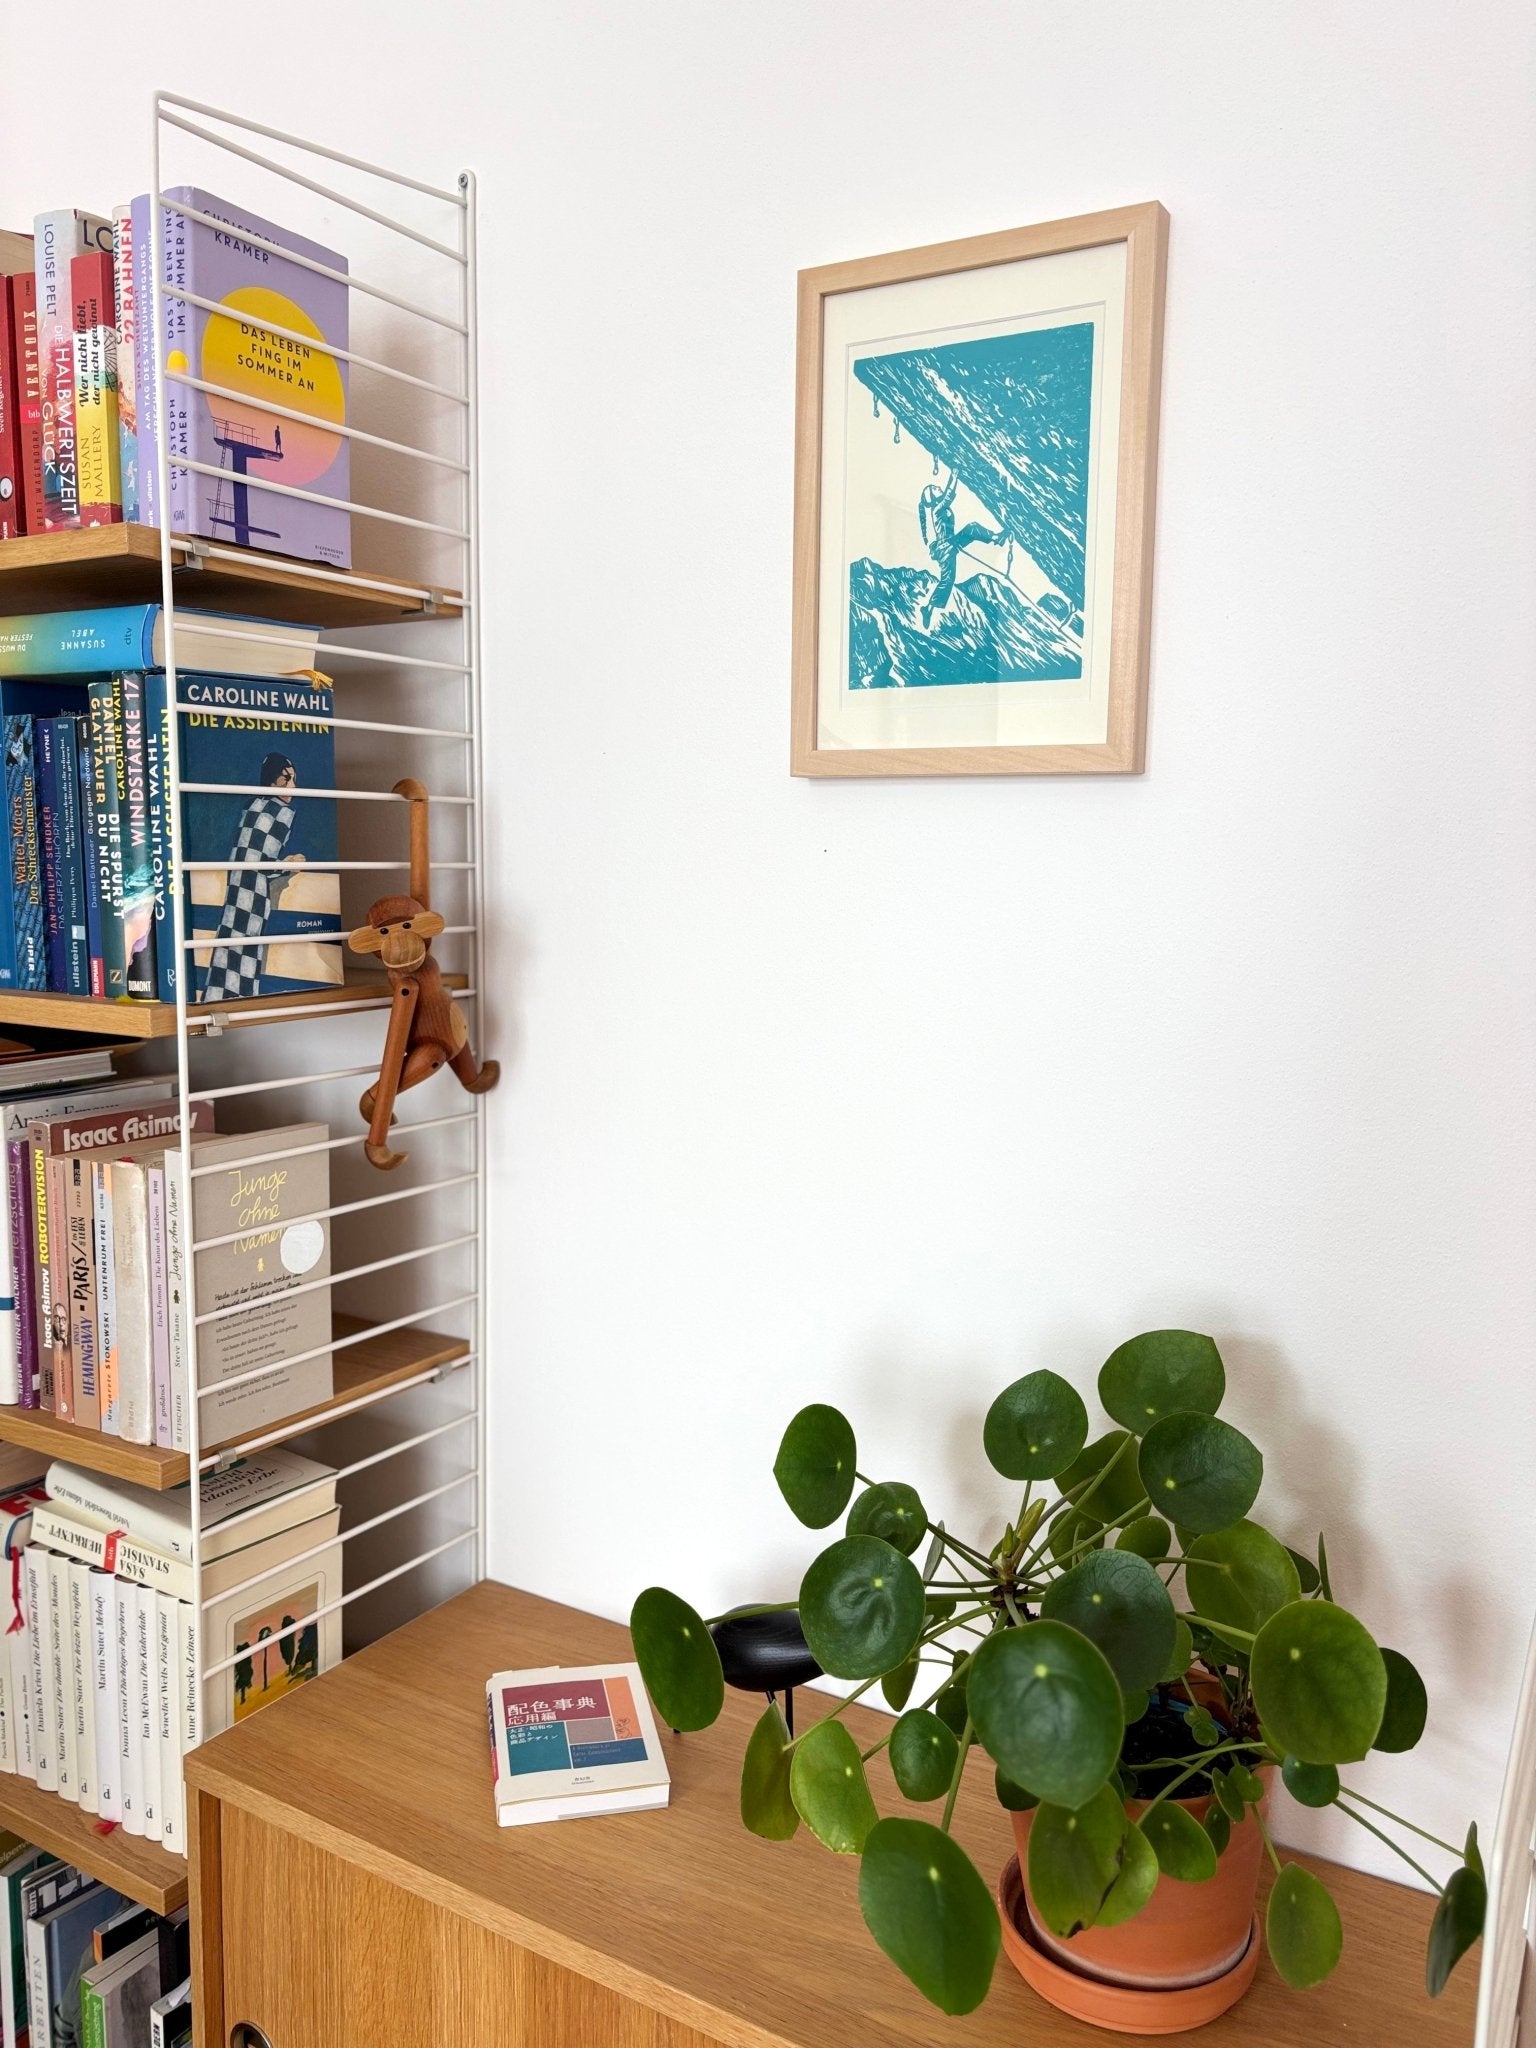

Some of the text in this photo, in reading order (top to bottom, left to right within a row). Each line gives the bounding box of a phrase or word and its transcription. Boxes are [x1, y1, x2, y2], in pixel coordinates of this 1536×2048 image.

[214, 231, 270, 265] KRAMER
[44, 224, 57, 316] LOUISE PELT
[166, 251, 174, 301] LBEN
[114, 267, 123, 345] CAROLINE
[141, 243, 149, 354] WELTUNTERGANGS
[166, 309, 174, 340] DAS
[177, 315, 186, 334] IM
[241, 323, 311, 359] DAS LEBEN
[23, 310, 39, 397] VENTOUX
[90, 298, 101, 406] der nicht gewinnt
[142, 358, 150, 381] DES
[251, 343, 302, 372] FING IM
[77, 338, 89, 408] Wer nicht
[237, 354, 315, 392] SOMMER AN
[54, 325, 77, 515] DIE HALBWERTSZEIT
[144, 412, 151, 430] AM
[42, 401, 56, 475] GLÜCK
[178, 411, 188, 476] KAMER
[32, 430, 43, 494] WAGENDORP
[80, 426, 104, 498] SUSAN MALLERY
[10, 633, 34, 642] FESTER
[60, 639, 106, 651] SUSANNE
[71, 628, 96, 638] ABEL
[123, 627, 132, 646] dtv
[187, 684, 330, 711] CAROLINE WAHL
[103, 697, 116, 765] DANIEL
[112, 678, 126, 801] CAROLINE WAHL
[189, 712, 330, 734] DIE ASSISTENTIN
[82, 747, 91, 789] Nordwind
[91, 698, 106, 804] GLATTAUER
[123, 678, 147, 847] WINDSTÄRKE 17
[85, 790, 93, 818] gegen
[12, 796, 28, 885] Walter Moers
[22, 775, 40, 905] Der Schrecksenmeister
[86, 819, 94, 835] Gut
[147, 733, 166, 921] CAROLINE WAHL
[42, 806, 58, 935] JAN-PHILIPP SENDKER
[97, 813, 111, 902] DU NICHT
[108, 813, 125, 920] DIE SPURST
[296, 919, 323, 928] ROMAN
[26, 937, 36, 972] PIPER
[70, 941, 81, 988] ullstein
[92, 960, 100, 994] GOLDMANN
[128, 980, 152, 993] DUMONT
[63, 1125, 119, 1152] Isaac
[122, 1111, 198, 1143] Asimov
[228, 1169, 288, 1207] Junge
[34, 1149, 50, 1265] ROBOTERVISION
[71, 1216, 79, 1233] FEST
[238, 1196, 281, 1227] ohne
[77, 1217, 86, 1240] LEBEN
[40, 1267, 52, 1315] Asimov
[99, 1219, 111, 1370] STOKOWSKI UNTENRUM FREI
[43, 1317, 53, 1349] Isaac
[173, 1313, 181, 1342] Tasane
[73, 1316, 95, 1397] ERNEST HEMINGWAY
[247, 1468, 278, 1485] Erbe
[49, 1524, 103, 1555] HERKUNFT
[28, 1568, 39, 1610] Ernstfall
[51, 1574, 59, 1609] Mondes
[31, 1625, 40, 1649] Liebe
[52, 1612, 60, 1628] des
[118, 1601, 128, 1647] Begehren
[32, 1649, 41, 1667] Die
[53, 1629, 61, 1653] Seite
[94, 1595, 107, 1691] Martin Suter Melody
[34, 1668, 43, 1695] Krien
[54, 1654, 62, 1685] dunkle
[138, 1609, 151, 1739] Ian McEwan Die Kakerlake
[185, 1625, 196, 1742] Anne Reinecke Leinsee
[56, 1686, 64, 1703] Die
[76, 1678, 84, 1703] Suter
[160, 1667, 170, 1739] Benedict Wells
[507, 1696, 598, 1717] 配色事典
[36, 1697, 46, 1732] Daniela
[57, 1705, 65, 1730] Suter
[77, 1706, 85, 1736] Martin
[120, 1698, 129, 1724] Leon
[507, 1711, 557, 1727] 応用編
[122, 1726, 130, 1759] Donna
